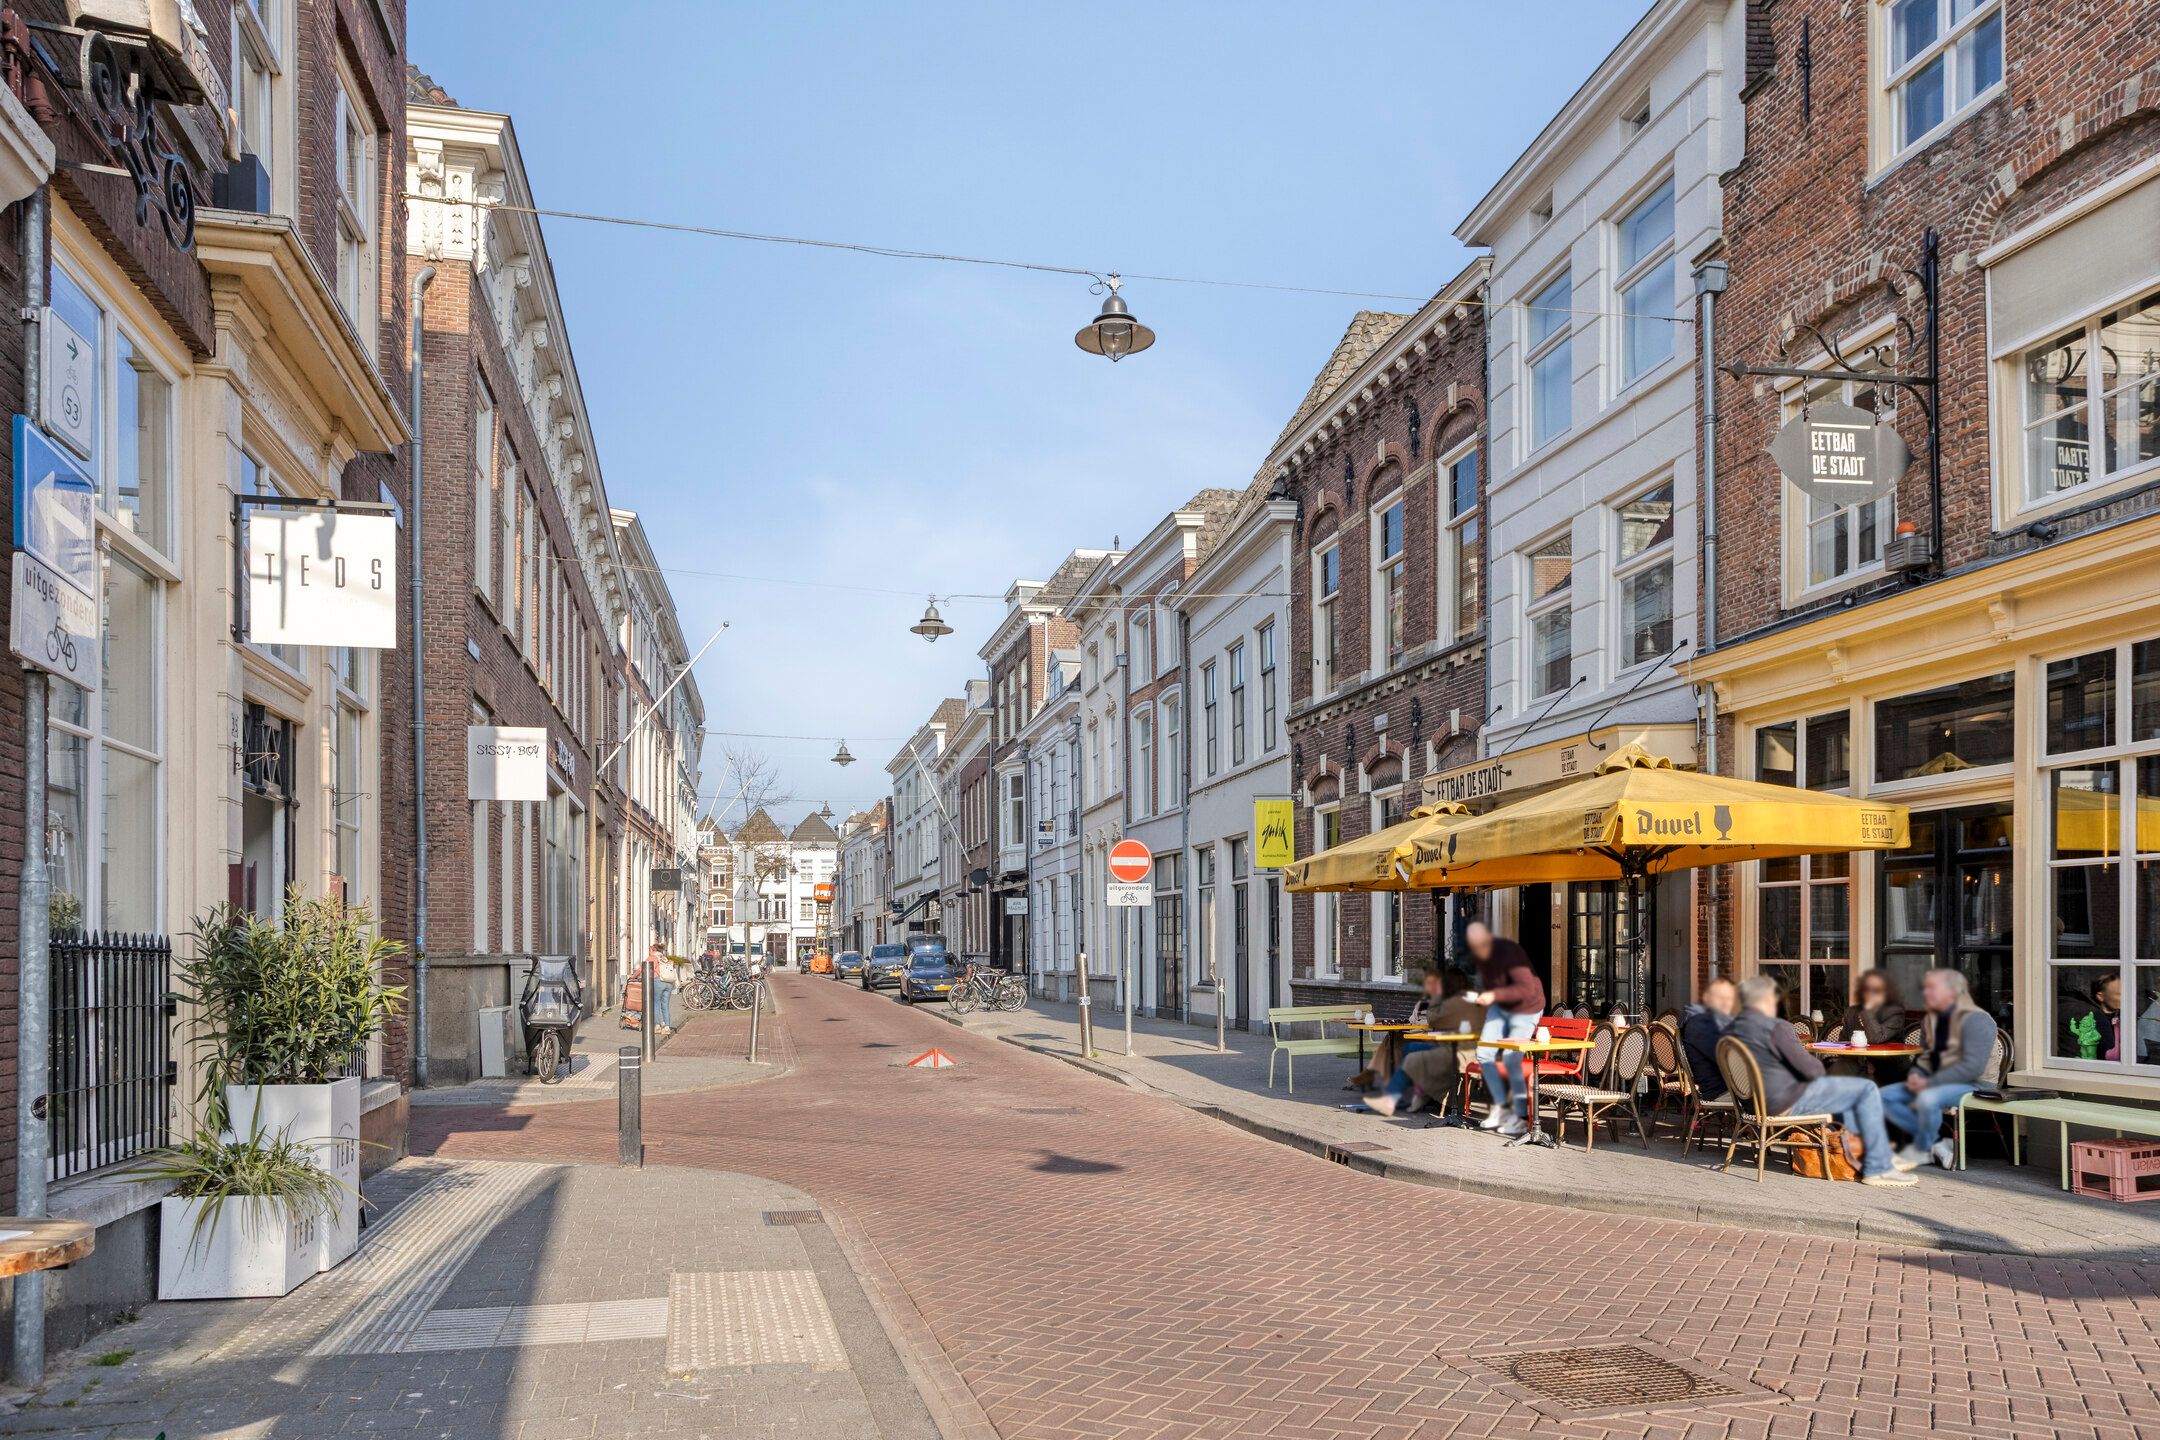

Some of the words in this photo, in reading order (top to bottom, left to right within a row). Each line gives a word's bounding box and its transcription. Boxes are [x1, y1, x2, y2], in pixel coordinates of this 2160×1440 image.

[65, 397, 79, 421] 53
[1811, 430, 1856, 452] EETBAR
[1830, 455, 1866, 477] STADT
[264, 552, 382, 590] TEDS
[25, 566, 95, 627] uitgezonderd
[1437, 774, 1466, 803] EETBAR
[1478, 764, 1503, 795] STADT
[1636, 808, 1702, 836] Duvel
[1861, 813, 1888, 826] EETBAR
[1872, 827, 1894, 839] STADT
[1415, 841, 1443, 865] Duvel
